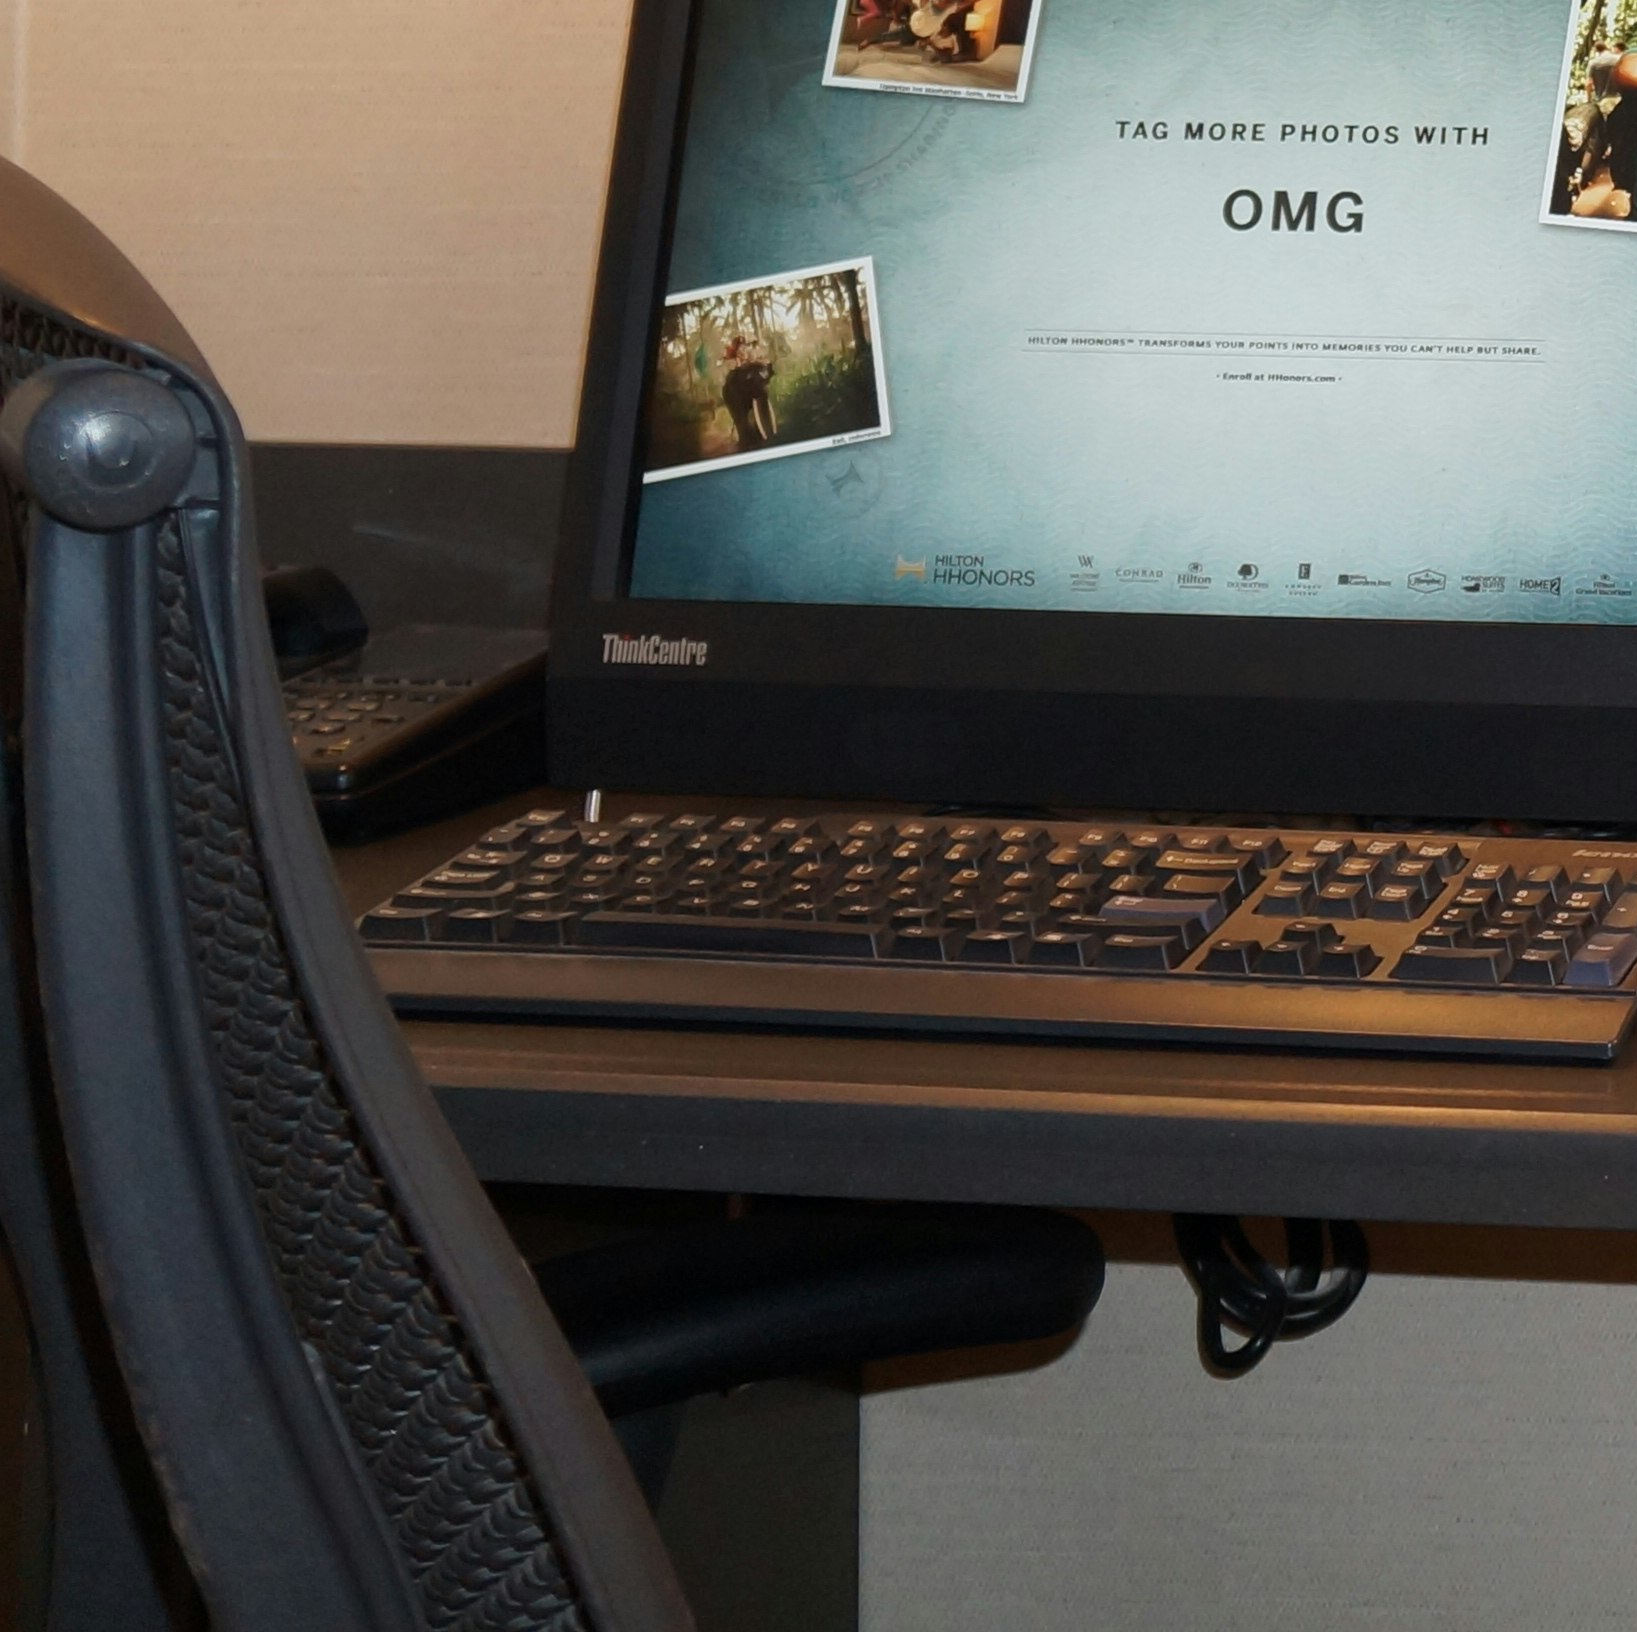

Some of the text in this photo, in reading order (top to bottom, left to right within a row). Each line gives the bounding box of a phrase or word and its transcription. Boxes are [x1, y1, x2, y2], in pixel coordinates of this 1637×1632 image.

[1115, 120, 1489, 145] TAG MORE PHOTOS WITH
[1222, 189, 1365, 233] OMG
[1028, 336, 1068, 346] HILTON
[1138, 339, 1212, 348] TRANSFORMS
[1215, 340, 1245, 349] YOUR
[1249, 341, 1288, 350] POINTS
[1291, 342, 1319, 351] INTO
[1322, 343, 1381, 352] MEMORIES
[1384, 344, 1407, 353] YOU
[1410, 345, 1443, 353] CAN'T
[1446, 345, 1474, 354] HELP
[1477, 346, 1498, 354] BUT
[1501, 346, 1542, 356] SHARE.
[1222, 372, 1336, 383] Enroll at HHonors.com
[934, 554, 984, 567] HILTON
[933, 569, 1036, 587] HHONORS
[1177, 574, 1212, 585] Hilton
[602, 633, 708, 665] ThinkCentre
